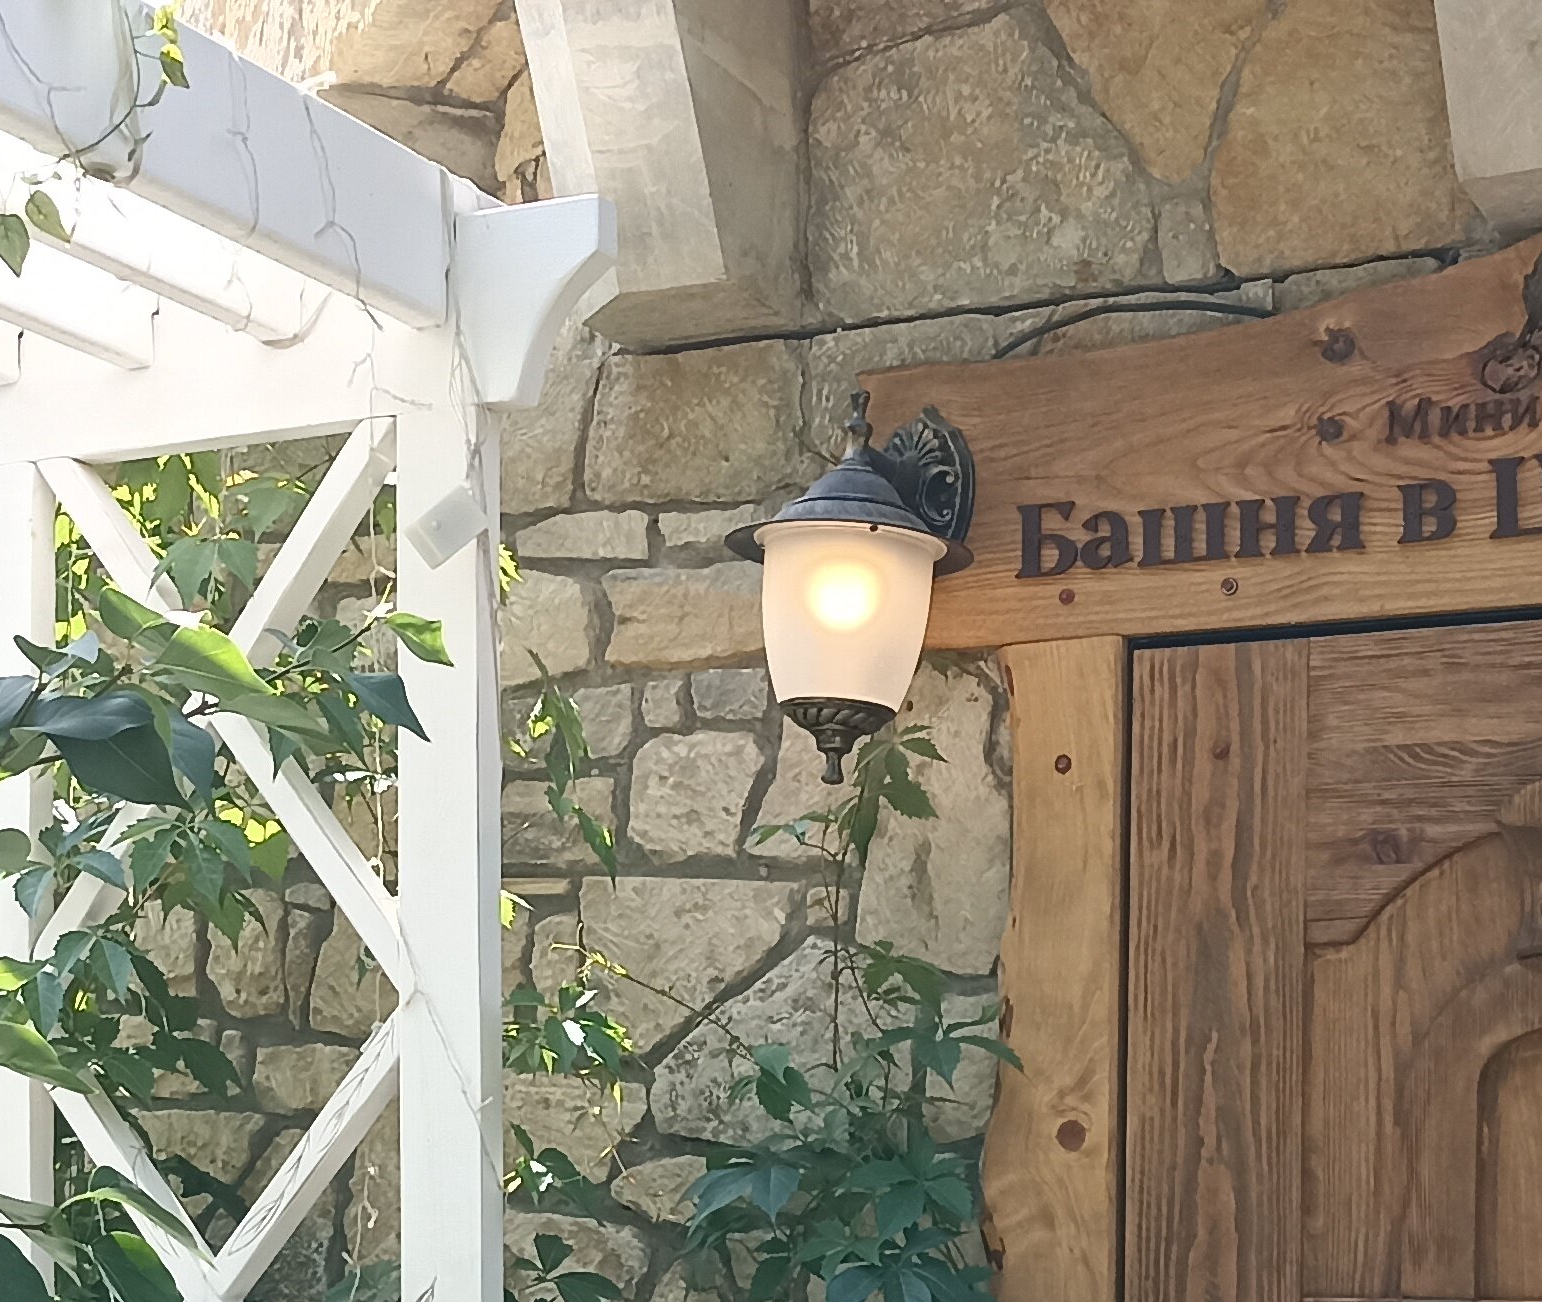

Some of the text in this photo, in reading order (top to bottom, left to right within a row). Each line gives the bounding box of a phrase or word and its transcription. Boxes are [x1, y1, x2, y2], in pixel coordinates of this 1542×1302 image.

[1385, 395, 1540, 444] Мини
[1014, 490, 1365, 580] Башня
[1396, 479, 1458, 545] в
